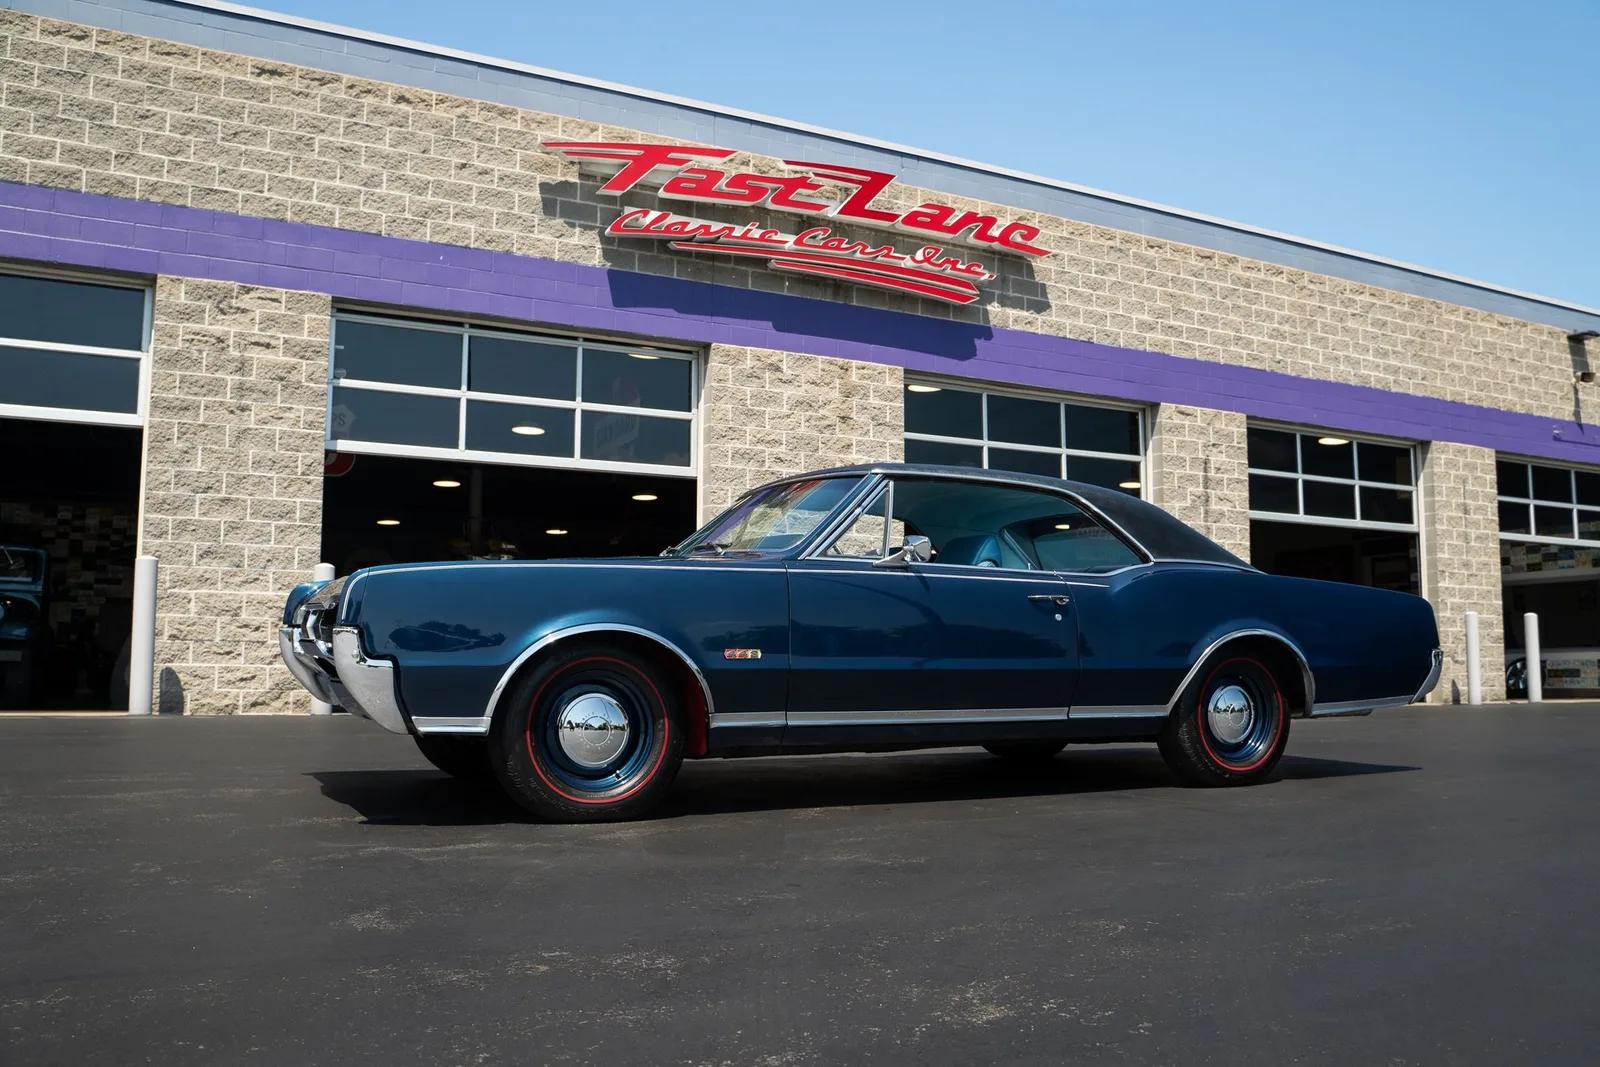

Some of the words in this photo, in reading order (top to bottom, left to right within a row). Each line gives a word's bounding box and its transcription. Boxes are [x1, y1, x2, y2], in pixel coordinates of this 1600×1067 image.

[541, 142, 832, 213] Fast
[782, 159, 1053, 258] Lane
[605, 208, 790, 248] Classic
[792, 227, 907, 260] Cars
